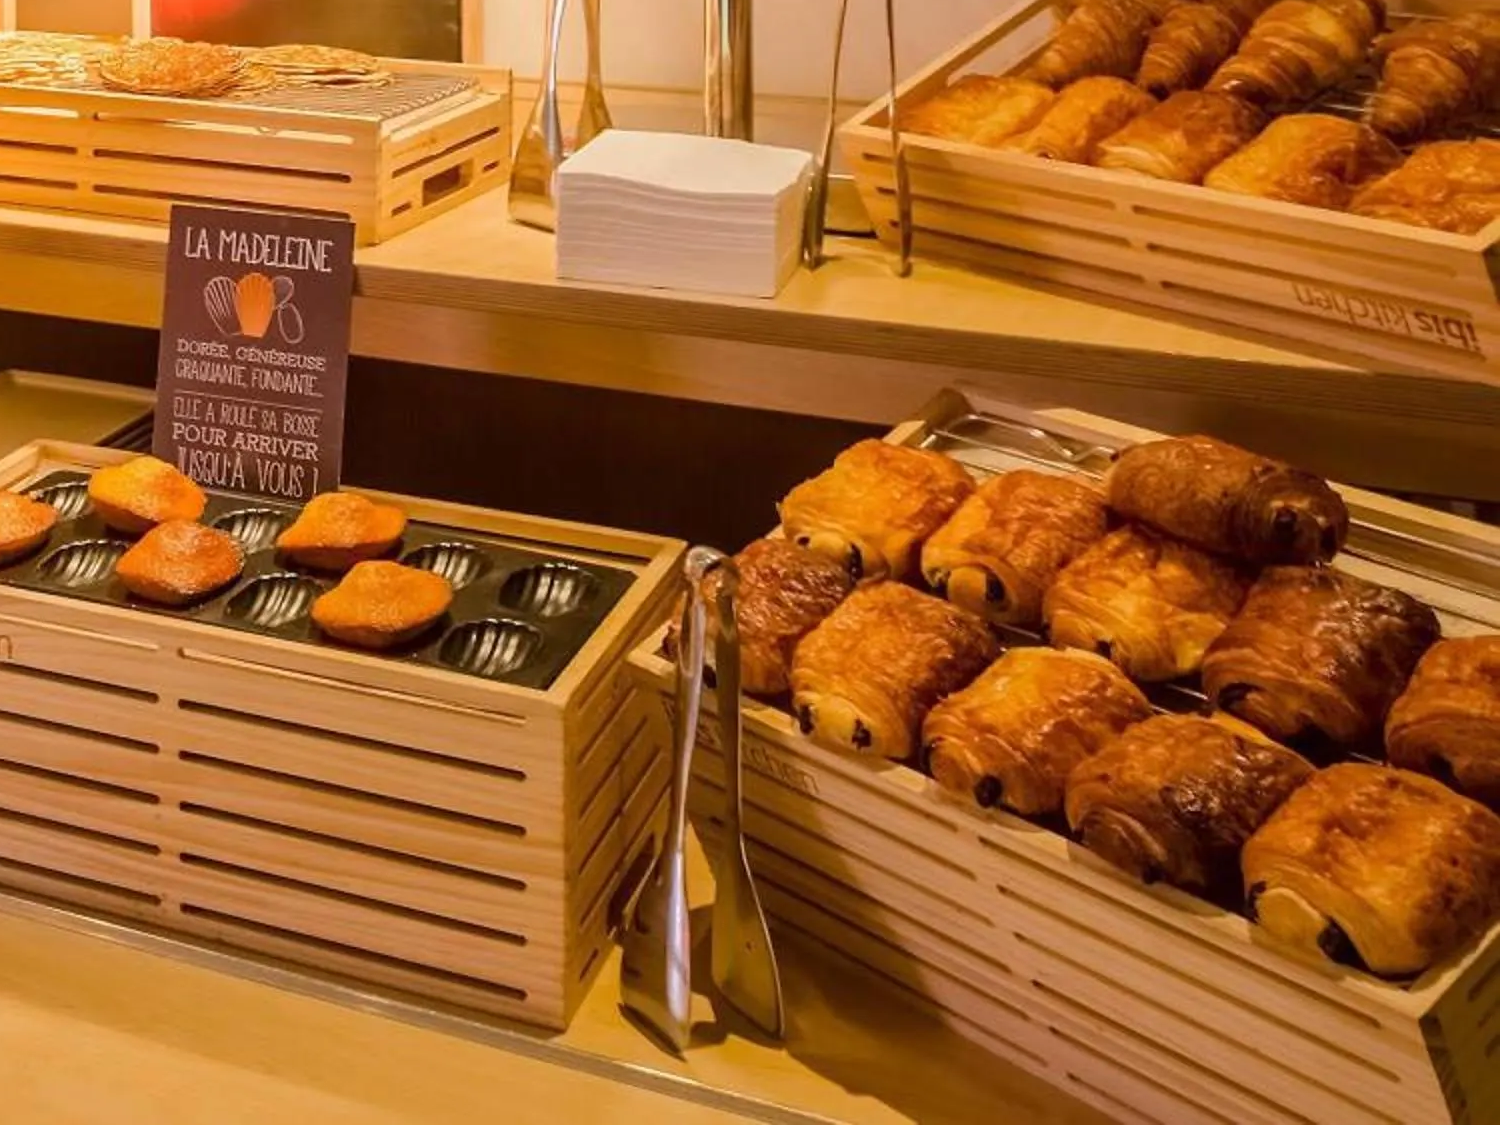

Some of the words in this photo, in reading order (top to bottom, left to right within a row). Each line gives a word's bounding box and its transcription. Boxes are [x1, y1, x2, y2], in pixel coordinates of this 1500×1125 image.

[185, 226, 211, 261] LA
[218, 229, 336, 273] MADELEINE
[1293, 283, 1411, 334] kitchen
[1413, 311, 1481, 353] ibis
[205, 402, 215, 423] A
[261, 409, 278, 432] SA
[283, 412, 321, 438] BOSSE
[172, 422, 227, 448] POUR
[232, 431, 319, 461] ARRIVER
[256, 458, 305, 498] VOUS
